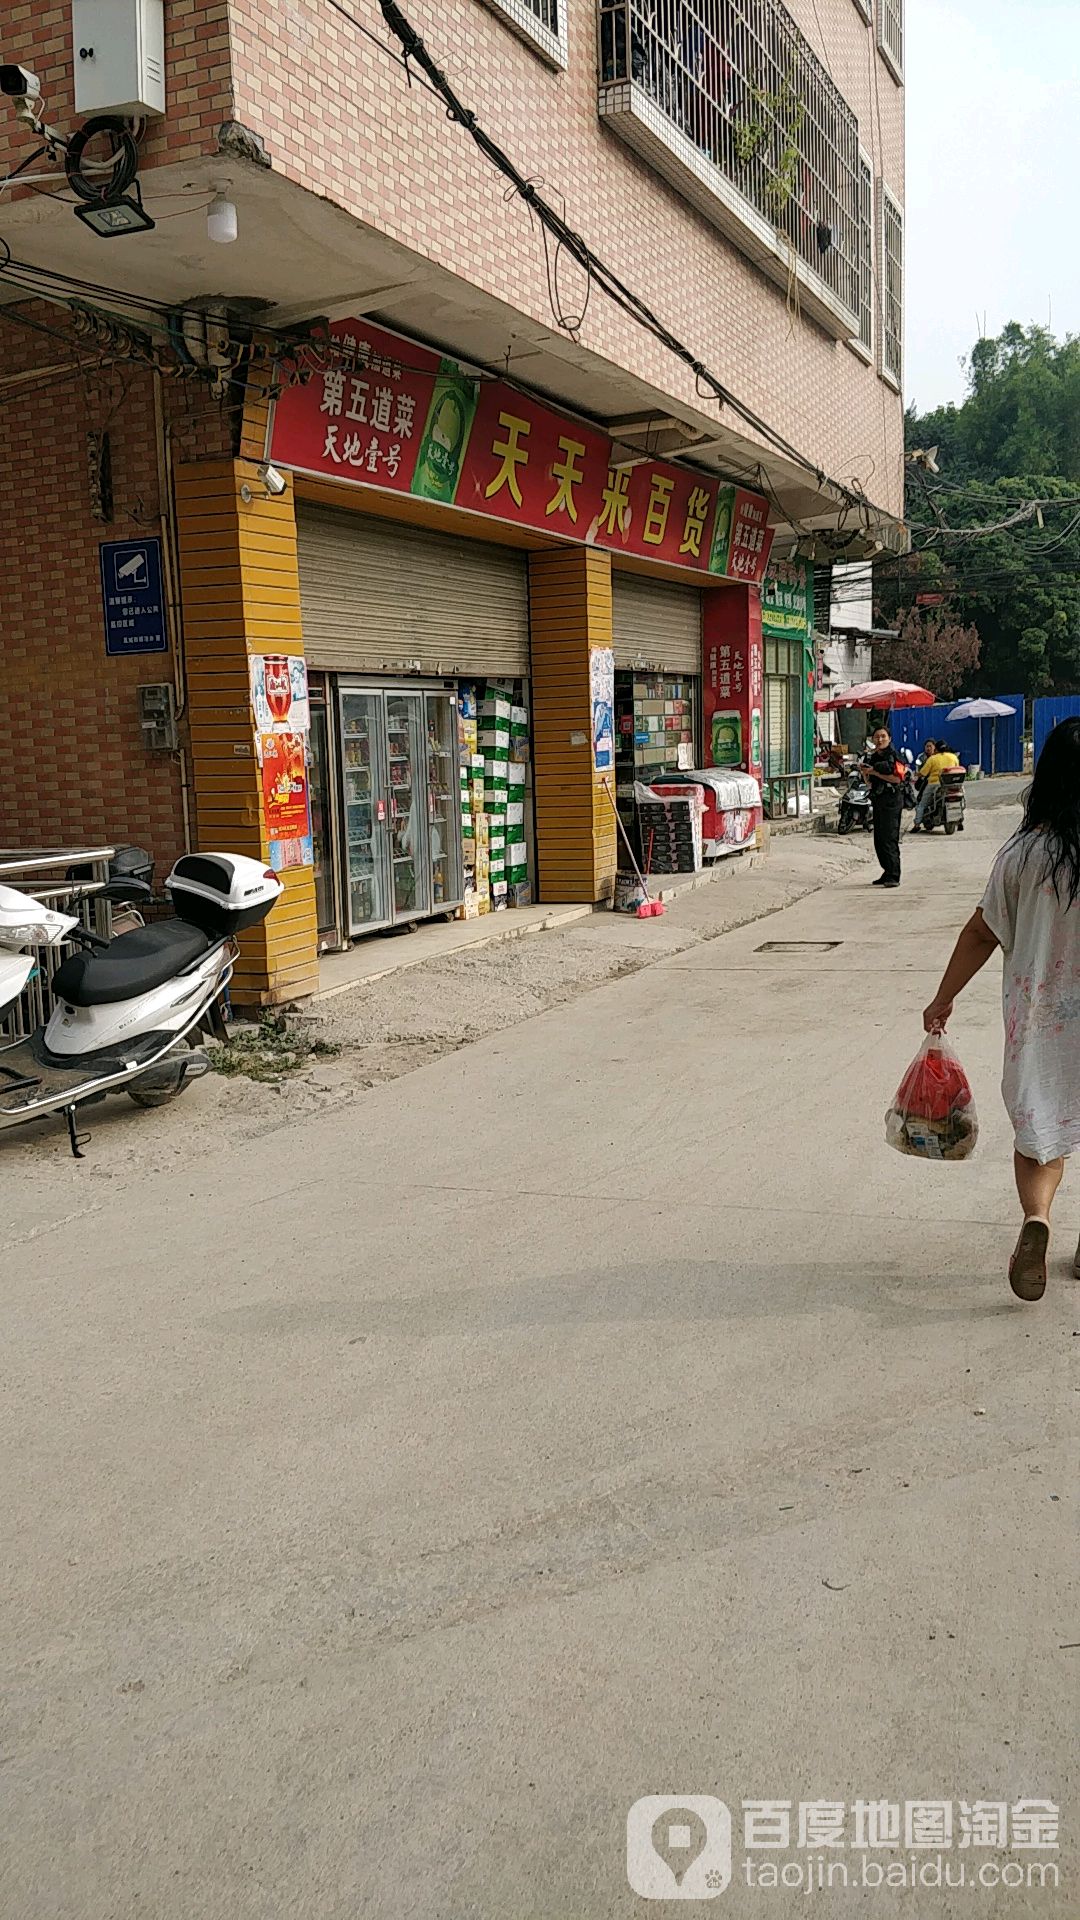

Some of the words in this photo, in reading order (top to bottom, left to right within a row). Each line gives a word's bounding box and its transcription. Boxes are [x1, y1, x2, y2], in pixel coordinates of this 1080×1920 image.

[319, 370, 417, 439] 第五道菜
[321, 424, 402, 478] 天地壹号
[484, 411, 711, 559] 天天来百货
[733, 520, 765, 553] 第五道菜
[719, 644, 731, 699] 第五道菜
[732, 650, 745, 693] 天地壹号
